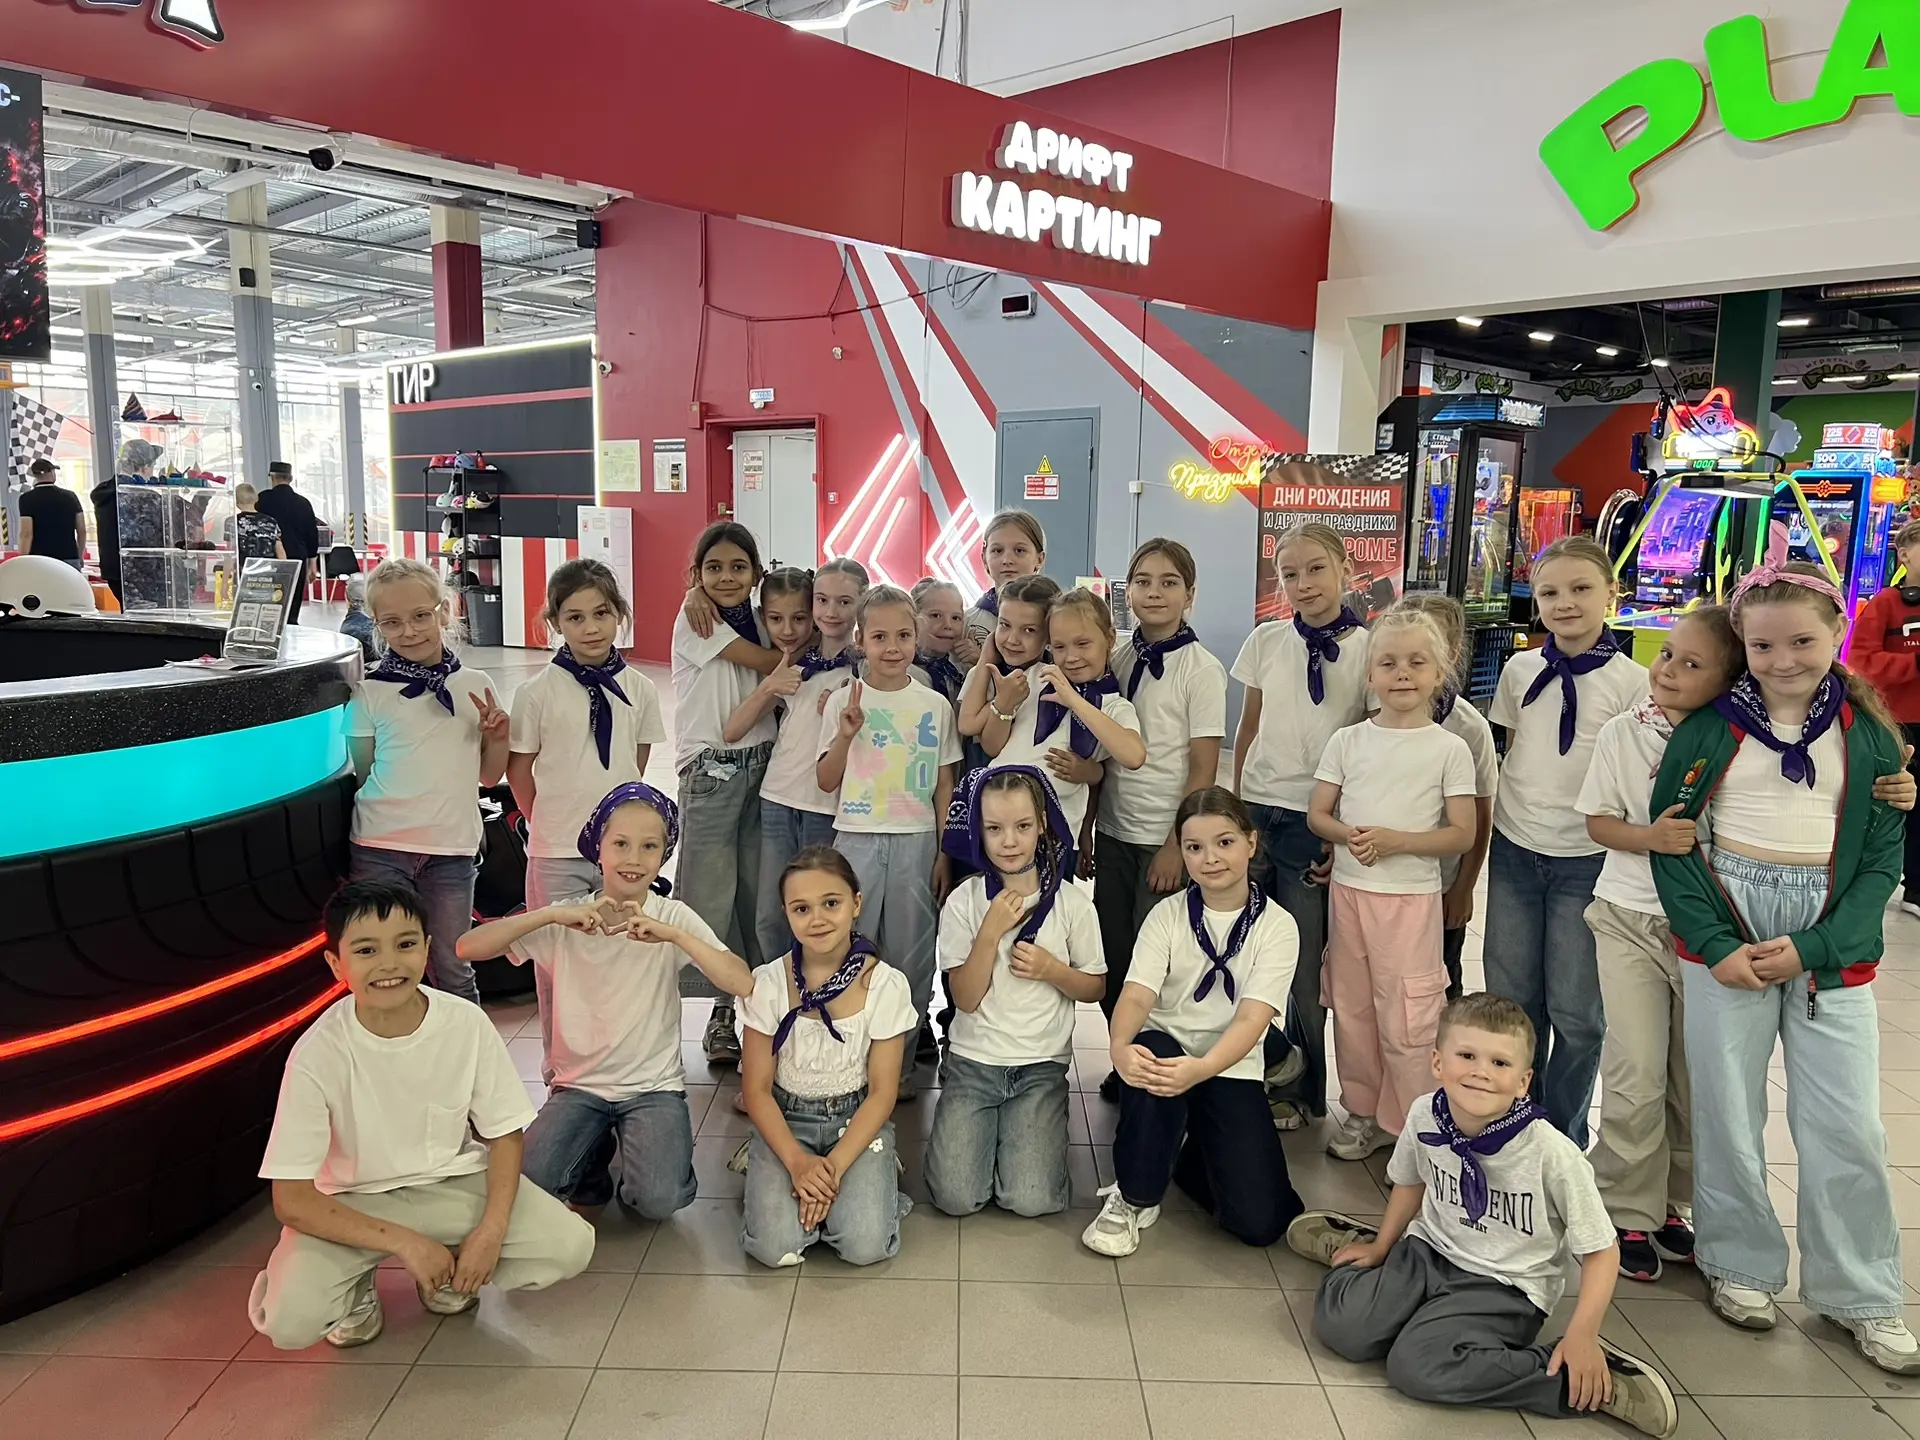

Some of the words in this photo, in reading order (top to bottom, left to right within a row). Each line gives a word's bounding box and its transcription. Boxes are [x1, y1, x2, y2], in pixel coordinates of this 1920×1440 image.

[1001, 120, 1134, 193] ДРИФТ
[957, 170, 1162, 267] КАРТИНГ
[388, 361, 436, 404] ТИР
[1816, 452, 1838, 463] 500
[1273, 487, 1305, 506] ДНИ
[1308, 488, 1391, 508] РОЖДЕНИЯ
[1264, 512, 1274, 528] И
[1274, 512, 1322, 529] ДРУГИЕ
[1323, 513, 1397, 531] ПРАЗДНИКИ
[1263, 534, 1275, 559] В
[1428, 1157, 1533, 1236] WEEND
